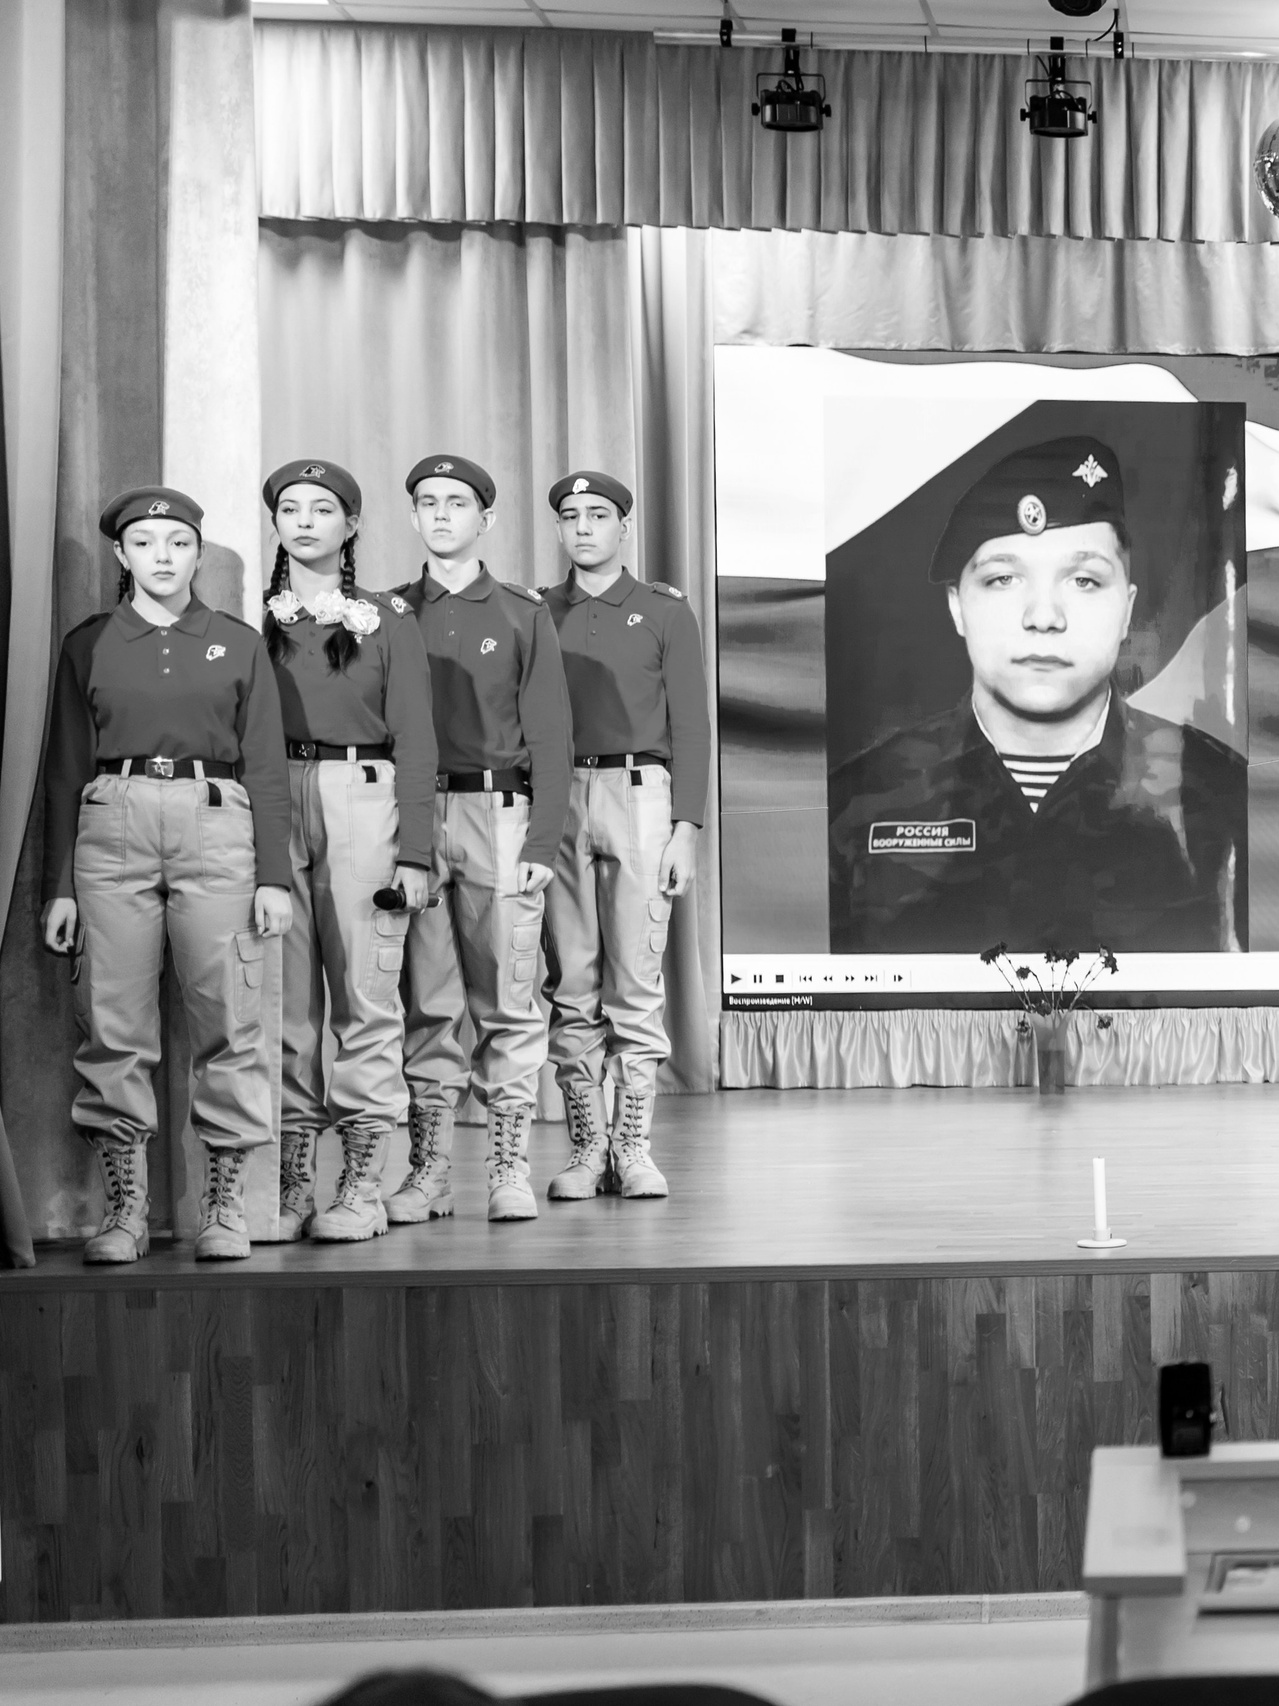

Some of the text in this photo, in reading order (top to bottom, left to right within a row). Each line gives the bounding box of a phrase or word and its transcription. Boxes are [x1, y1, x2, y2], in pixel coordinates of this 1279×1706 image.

[896, 826, 948, 837] РОССИЯ
[873, 837, 971, 848] ВООРУЖЕННЫЕ СИЛЫ
